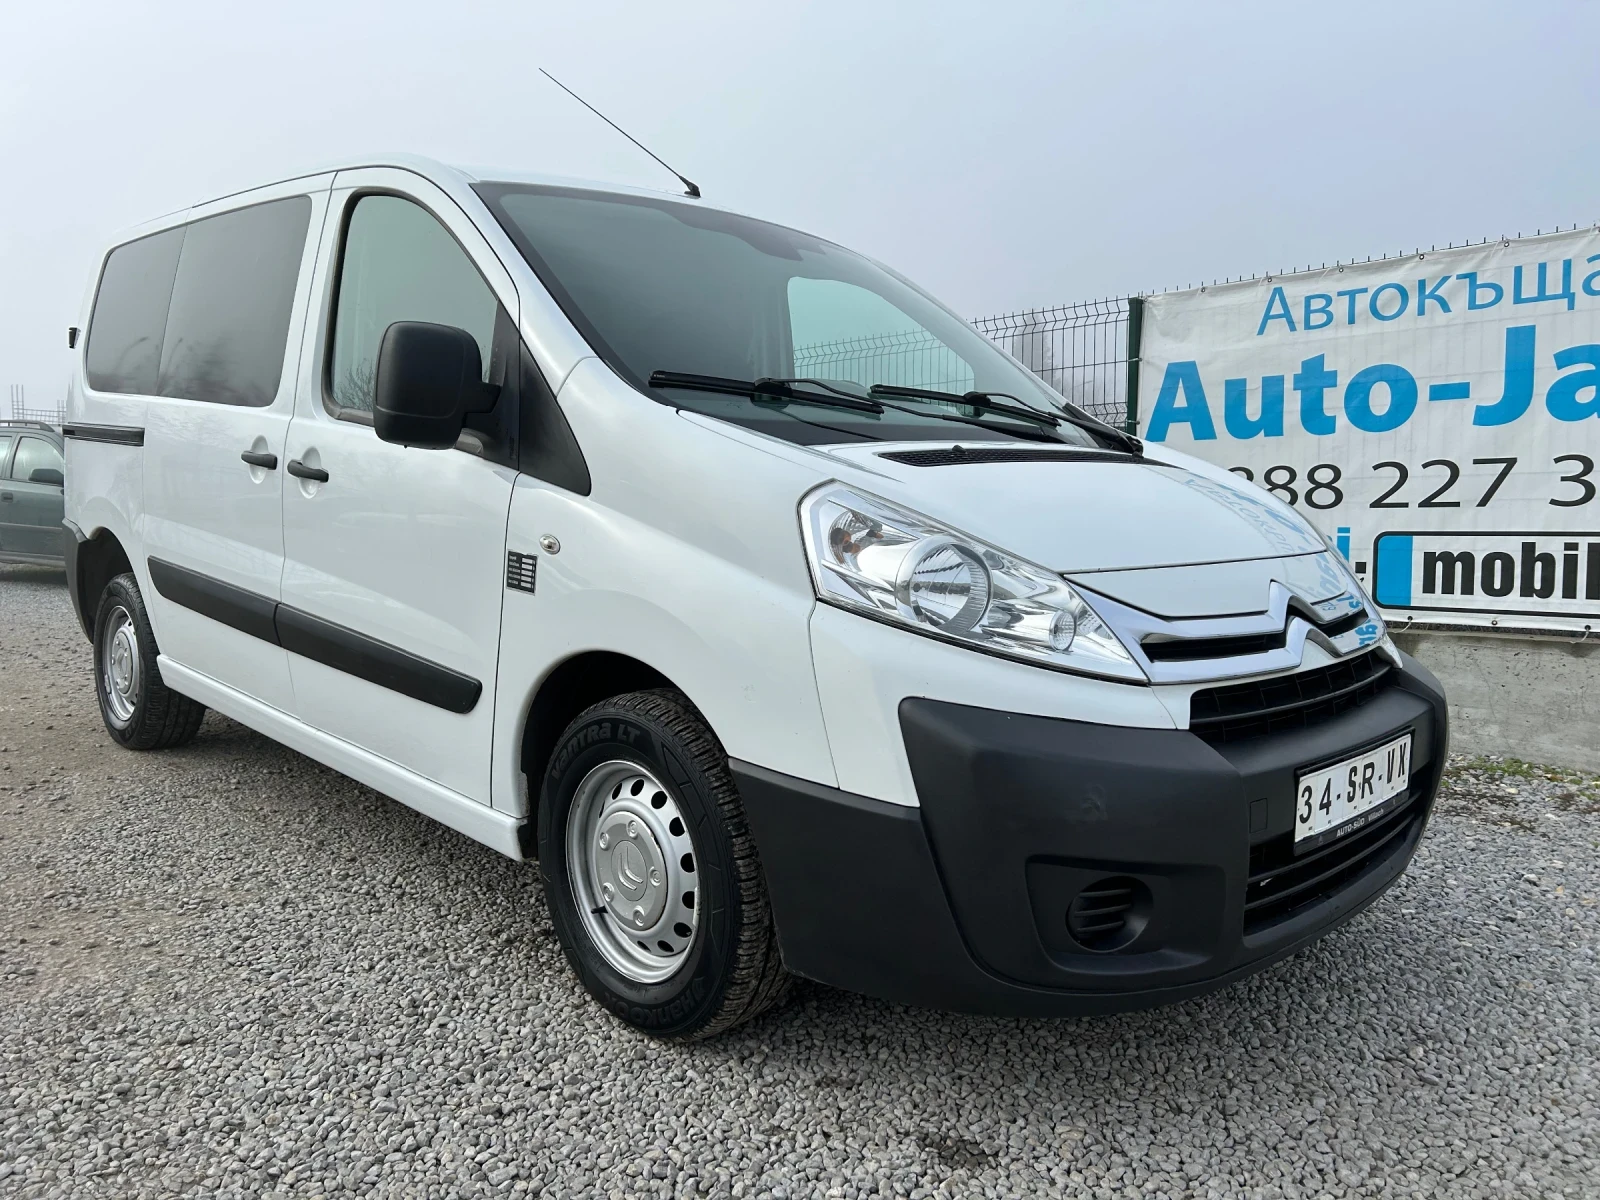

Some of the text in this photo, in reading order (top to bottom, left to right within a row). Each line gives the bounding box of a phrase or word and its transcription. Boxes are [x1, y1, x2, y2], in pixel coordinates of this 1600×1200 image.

[1228, 454, 1597, 509] 88 227 3
[617, 724, 641, 744] LT
